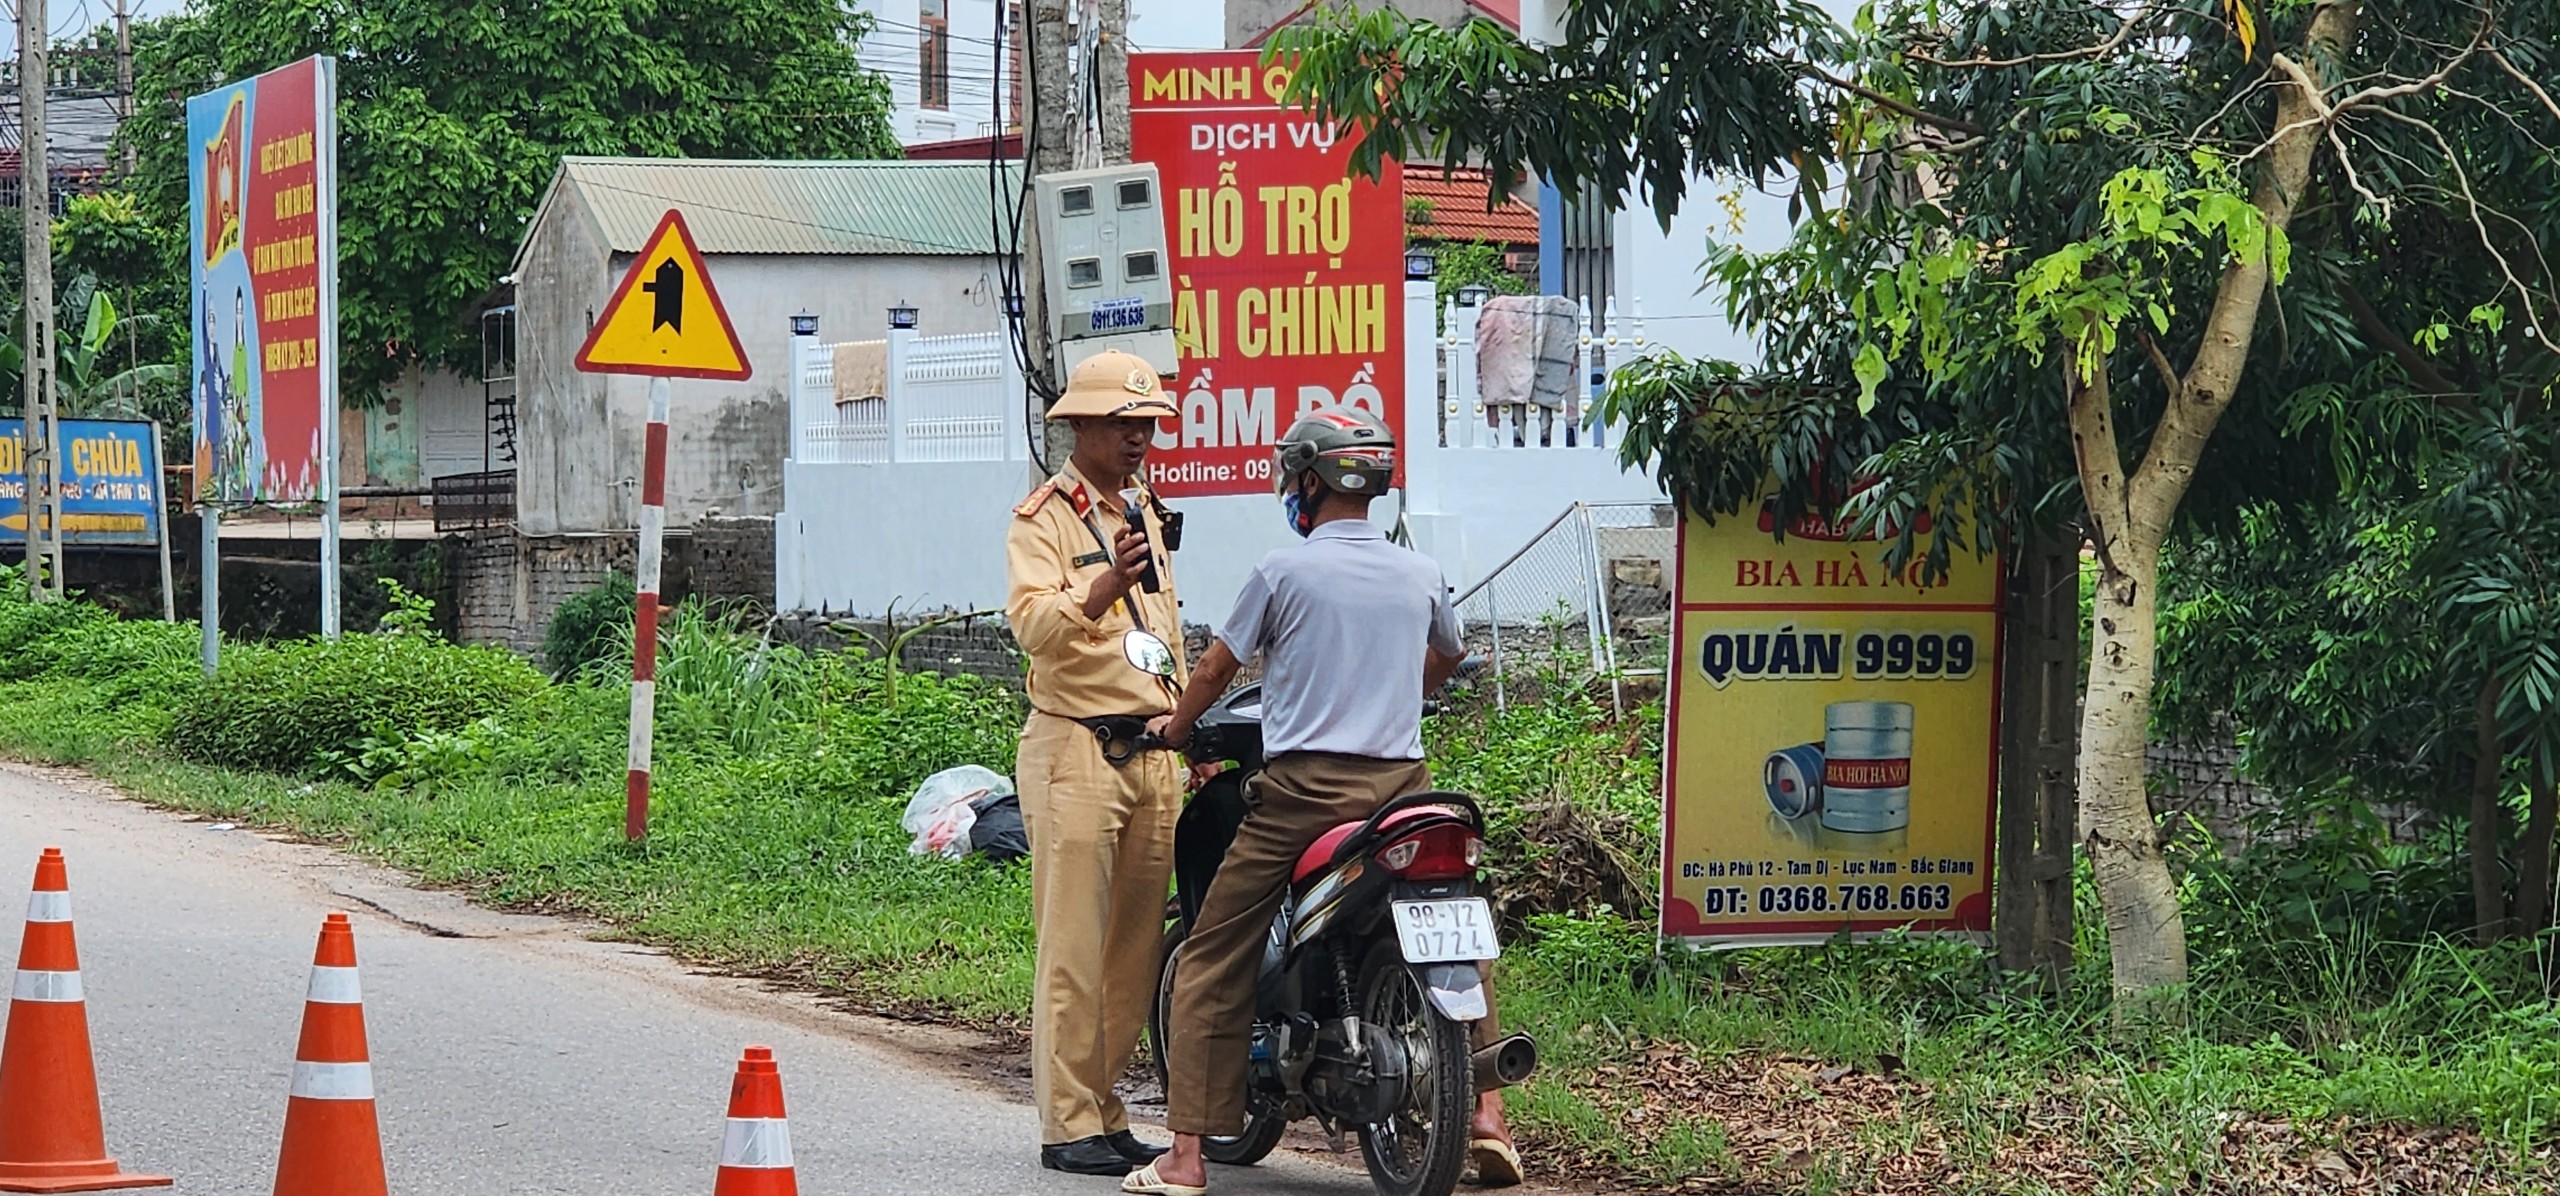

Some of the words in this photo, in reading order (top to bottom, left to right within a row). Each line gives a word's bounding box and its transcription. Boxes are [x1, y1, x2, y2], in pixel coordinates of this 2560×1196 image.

[1143, 66, 1251, 101] MINH
[1191, 123, 1275, 156] DỊCH
[1287, 121, 1335, 153] VỤ
[1180, 161, 1243, 258] HỖ
[1259, 177, 1352, 269] TRỢ
[1092, 307, 1144, 329] 0911.136.636
[1175, 275, 1220, 359] ÀI
[1237, 271, 1386, 358] CHÍNH
[71, 432, 143, 478] CHÙA
[1150, 461, 1237, 484] Hotline:
[1735, 560, 1802, 586] BIA
[1813, 551, 1869, 586] HÀ
[1702, 625, 1842, 683] QUÁN
[1856, 634, 1974, 674] 9999
[1827, 765, 1844, 782] BIA
[1870, 762, 1886, 783] HÀ
[1683, 862, 1704, 878] ĐC:
[1709, 861, 1725, 877] Hà
[1759, 861, 1773, 875] 12
[1787, 860, 1811, 875] Tam
[1843, 859, 1865, 878] Lục
[1869, 860, 1896, 874] Nam
[1911, 856, 1934, 874] Bắc
[1706, 887, 1747, 914] ĐT:
[1758, 884, 1950, 913] 0368.768.663
[1408, 903, 1478, 929] 98-Y2
[1415, 930, 1484, 957] 0724
